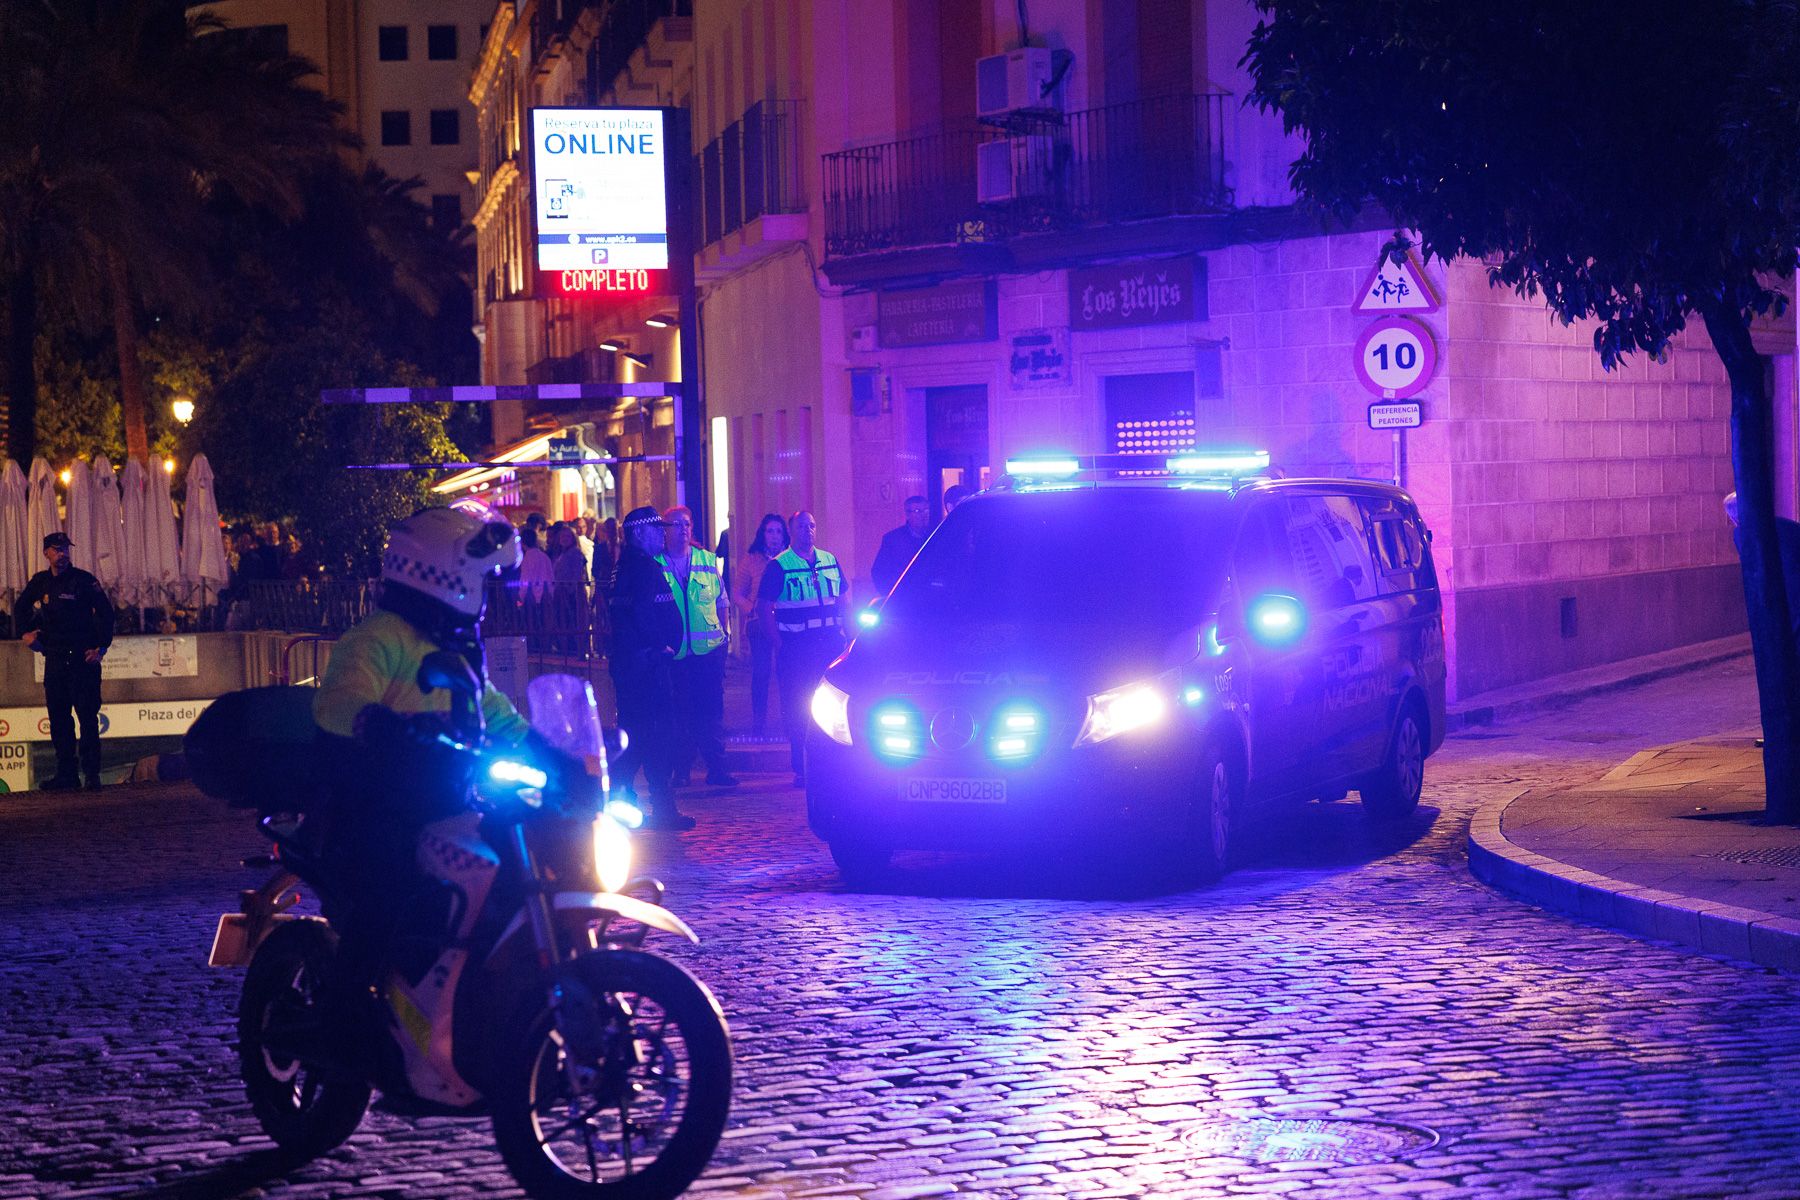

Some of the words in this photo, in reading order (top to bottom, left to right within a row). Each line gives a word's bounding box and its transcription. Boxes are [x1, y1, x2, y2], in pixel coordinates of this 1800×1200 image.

[545, 117, 599, 129] Reserva
[603, 119, 615, 129] tu
[619, 118, 653, 131] plaza
[544, 133, 654, 154] ONLINE
[562, 269, 648, 291] COMPLETO
[1082, 281, 1115, 320] Los
[1120, 278, 1180, 317] Reyes
[1372, 342, 1416, 370] 10
[1372, 406, 1418, 414] PREFERENCIA
[138, 709, 173, 721] Plaza
[177, 707, 196, 719] del
[7, 761, 26, 770] APP
[909, 781, 1004, 800] CNP9602BB
